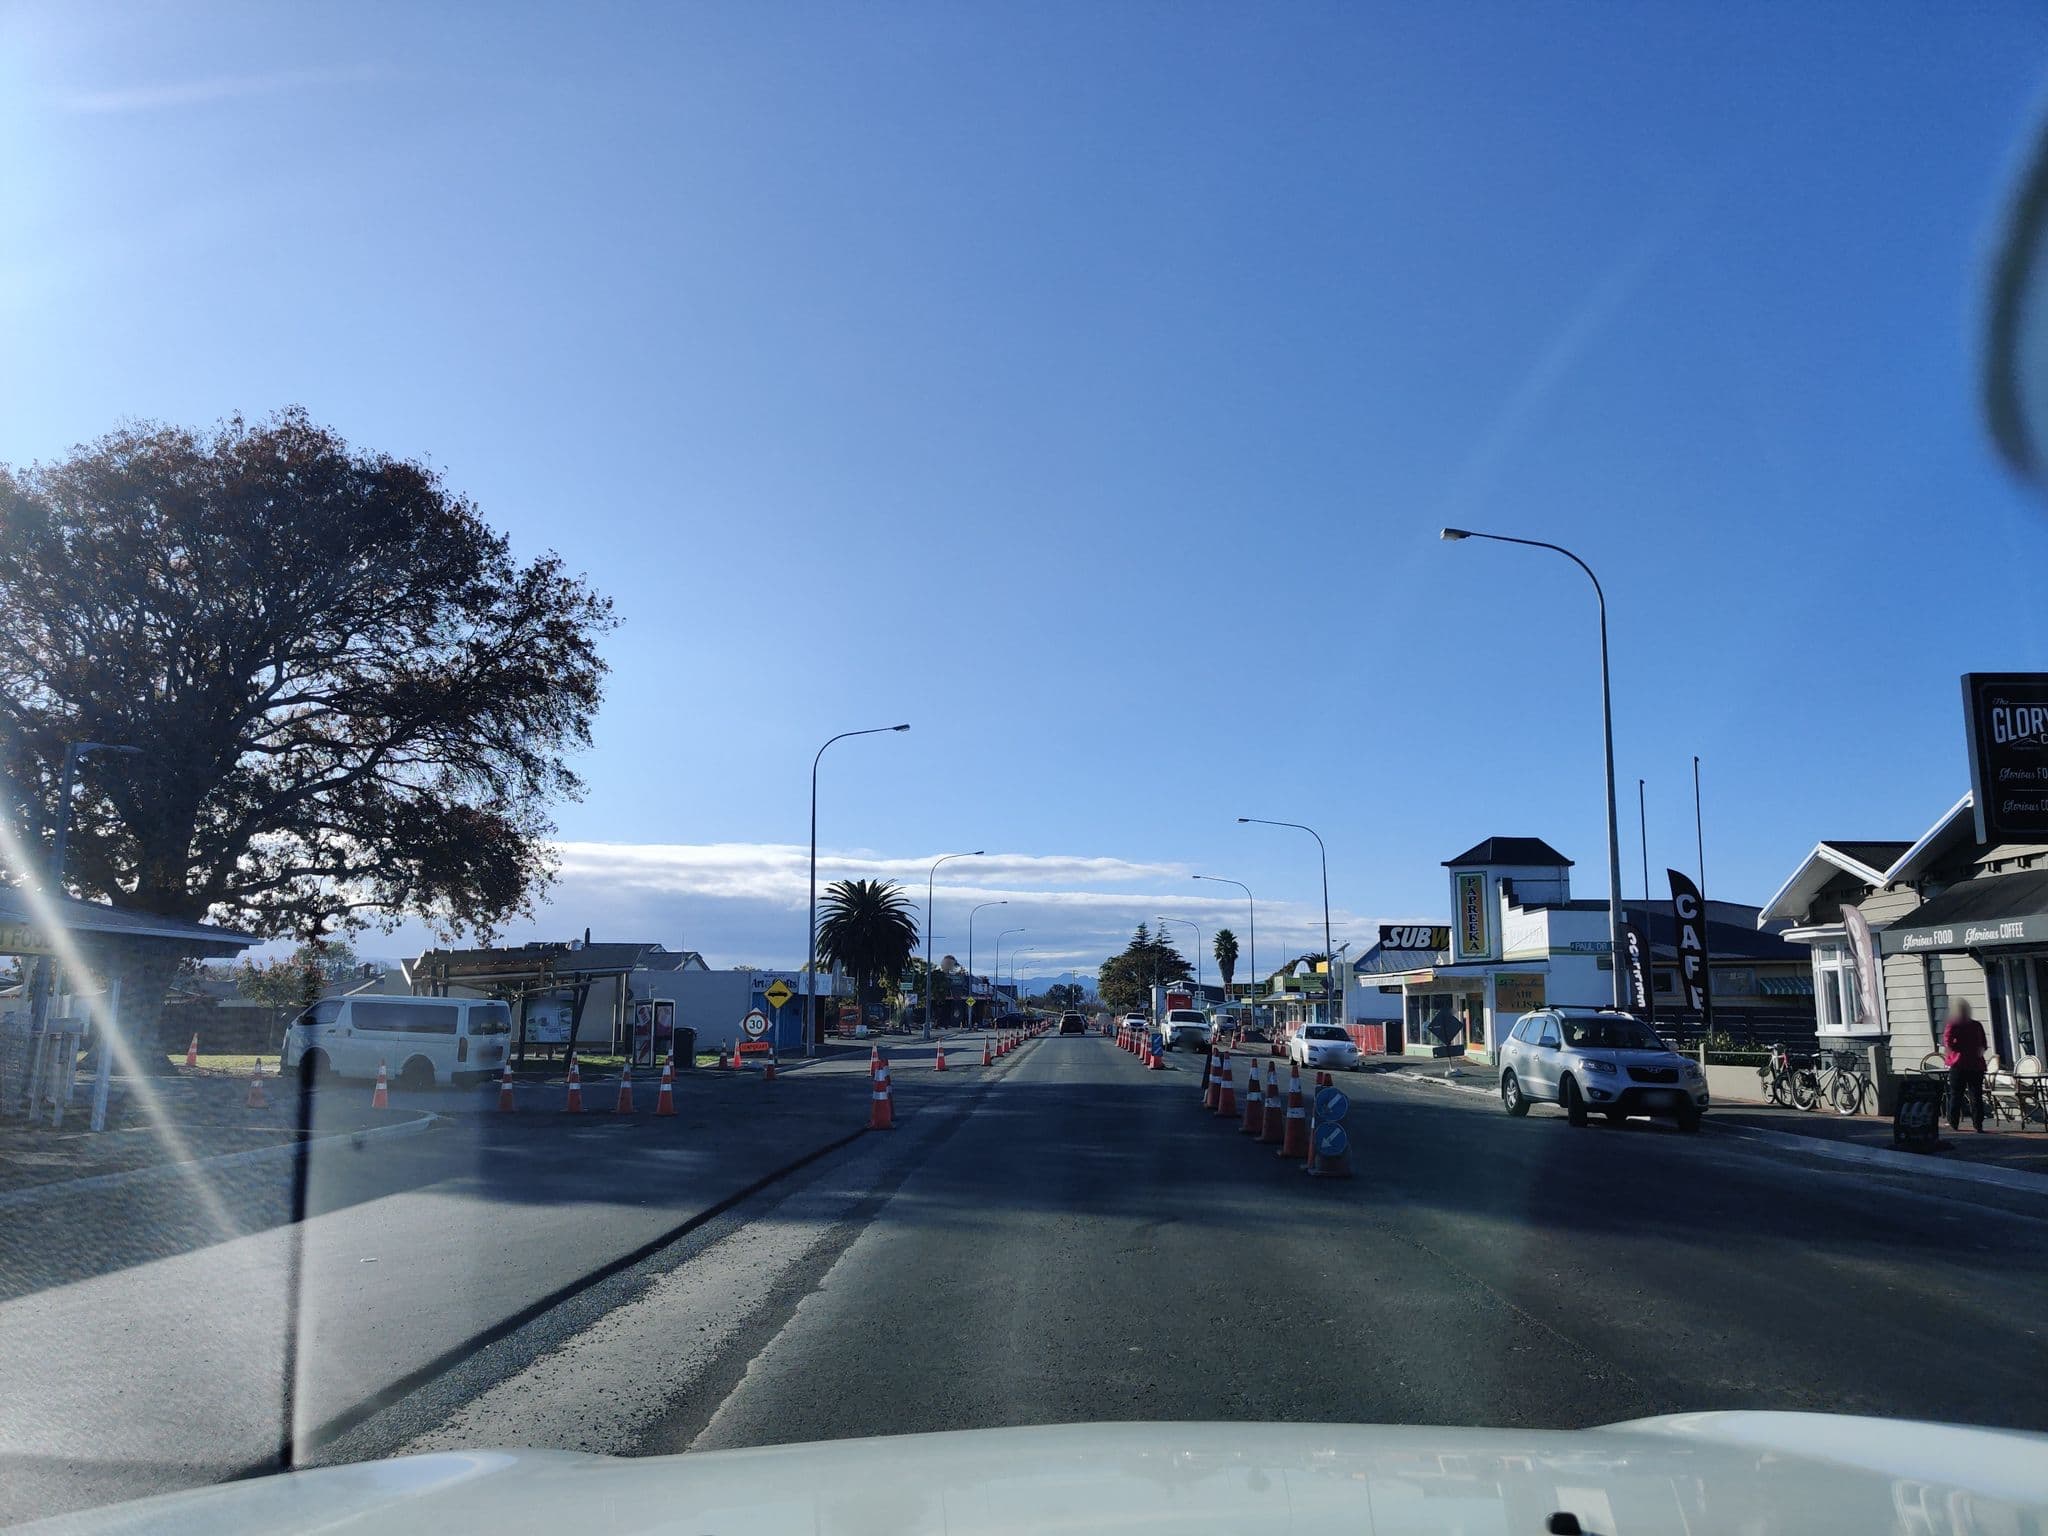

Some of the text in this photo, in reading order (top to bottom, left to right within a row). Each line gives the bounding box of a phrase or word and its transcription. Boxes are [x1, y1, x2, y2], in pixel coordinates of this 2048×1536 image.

[1466, 877, 1480, 951] PAPREEKA
[1902, 921, 2025, 951] Glorious FOOD Glorious COFFEE
[1575, 942, 1594, 951] PAUL
[749, 1020, 763, 1029] 30
